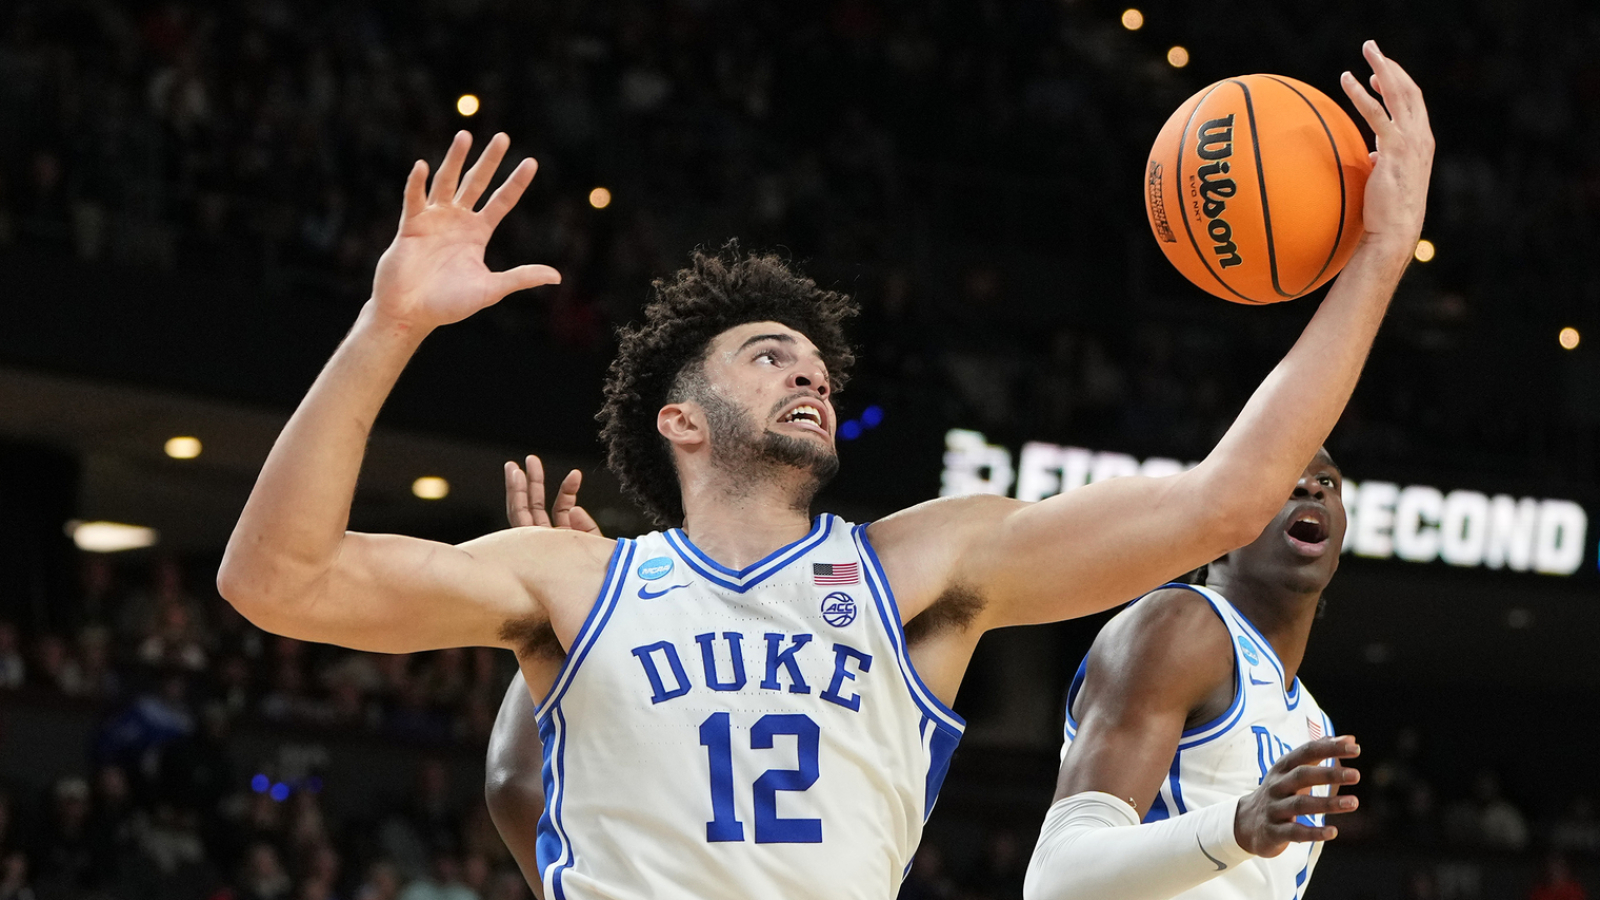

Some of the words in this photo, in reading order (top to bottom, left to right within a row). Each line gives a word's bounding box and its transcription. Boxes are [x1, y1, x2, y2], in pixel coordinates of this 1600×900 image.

[1189, 174, 1197, 198] EVO
[1193, 200, 1202, 223] NXT
[1196, 113, 1243, 269] Wilson
[825, 602, 855, 612] ACC
[631, 632, 873, 713] DUKE
[699, 711, 823, 844] 12
